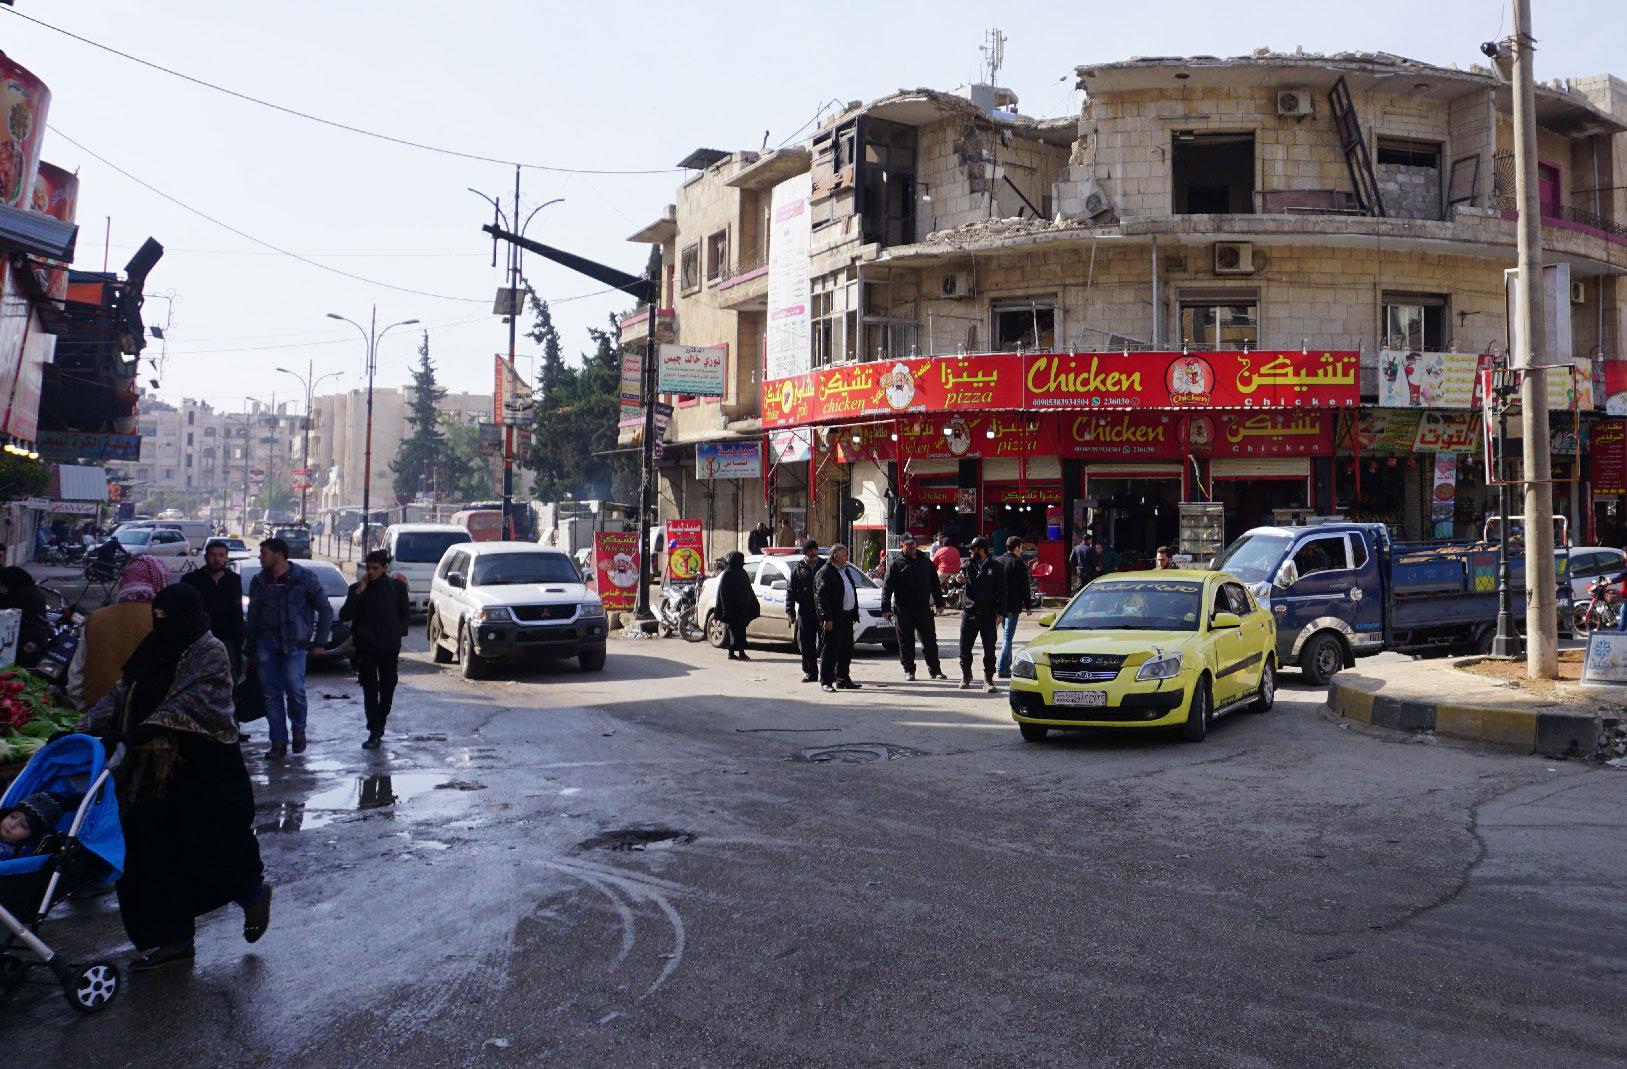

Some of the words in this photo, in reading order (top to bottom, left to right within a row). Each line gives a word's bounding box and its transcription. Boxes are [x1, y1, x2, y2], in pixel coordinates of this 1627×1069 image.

[941, 361, 998, 389] بيتزا
[1027, 355, 1143, 394] Chicken
[1236, 353, 1357, 394] تشيكن
[822, 396, 865, 414] chicken
[944, 389, 993, 408] pizza
[1244, 397, 1354, 407] Chicken
[1072, 414, 1165, 443] Chicken
